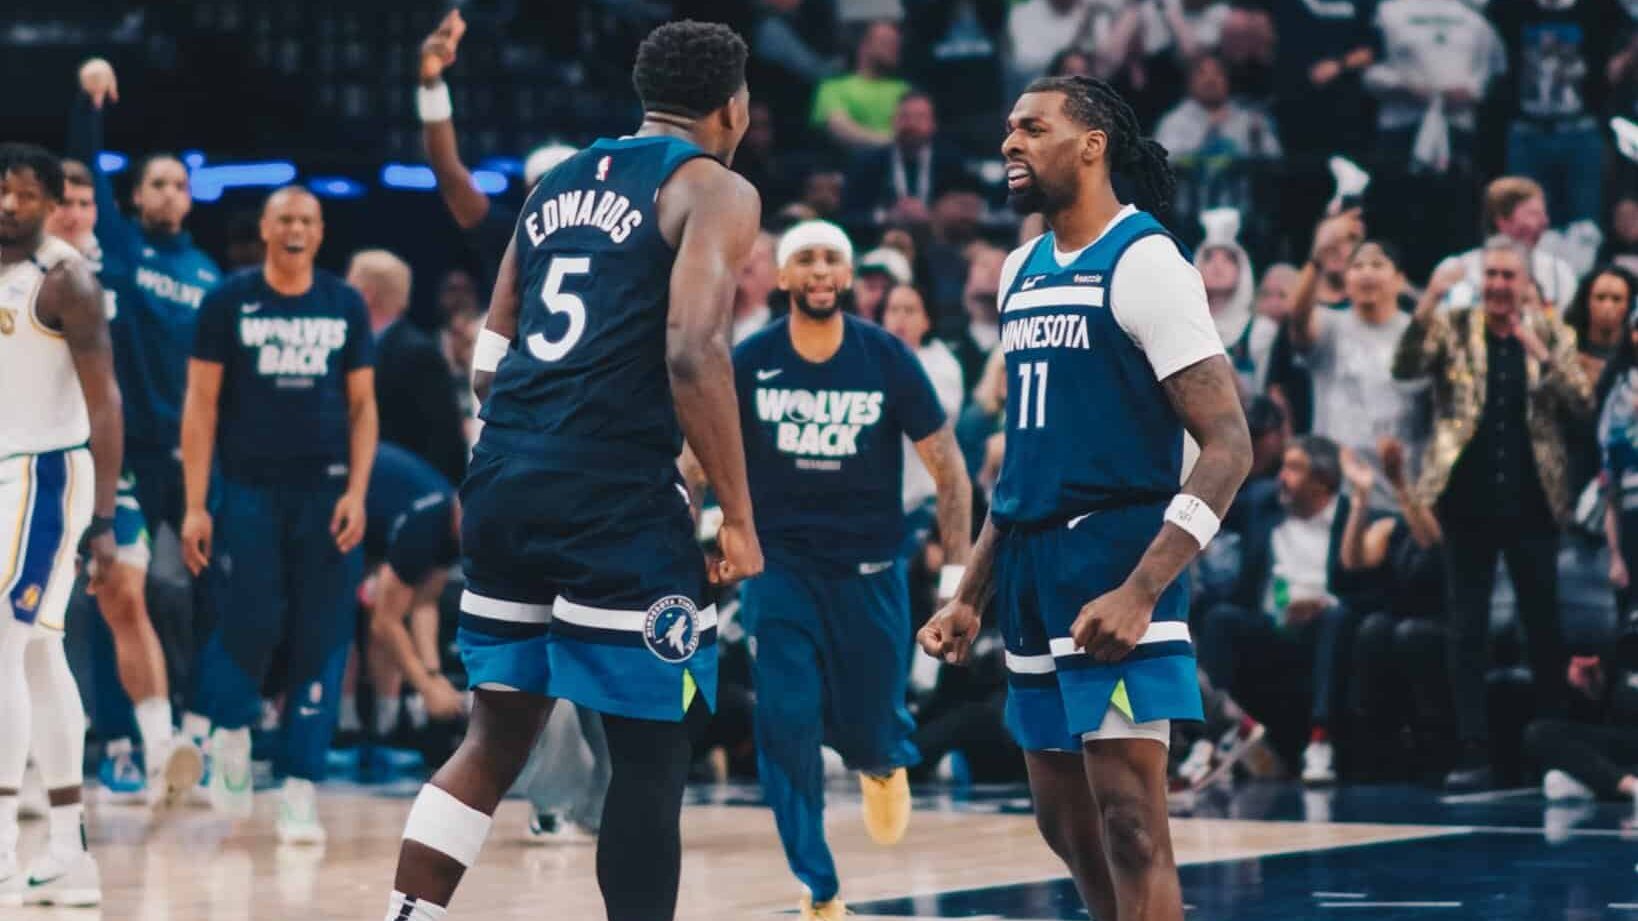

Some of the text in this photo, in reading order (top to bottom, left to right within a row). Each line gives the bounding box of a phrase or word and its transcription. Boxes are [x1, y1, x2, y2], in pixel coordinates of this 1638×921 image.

[525, 189, 643, 247] EDWARDS
[526, 256, 590, 362] 5
[240, 316, 347, 349] WOLVES
[258, 345, 329, 375] BACK
[756, 388, 883, 425] WOLVES
[1018, 361, 1049, 430] 11
[778, 422, 861, 455] BACK
